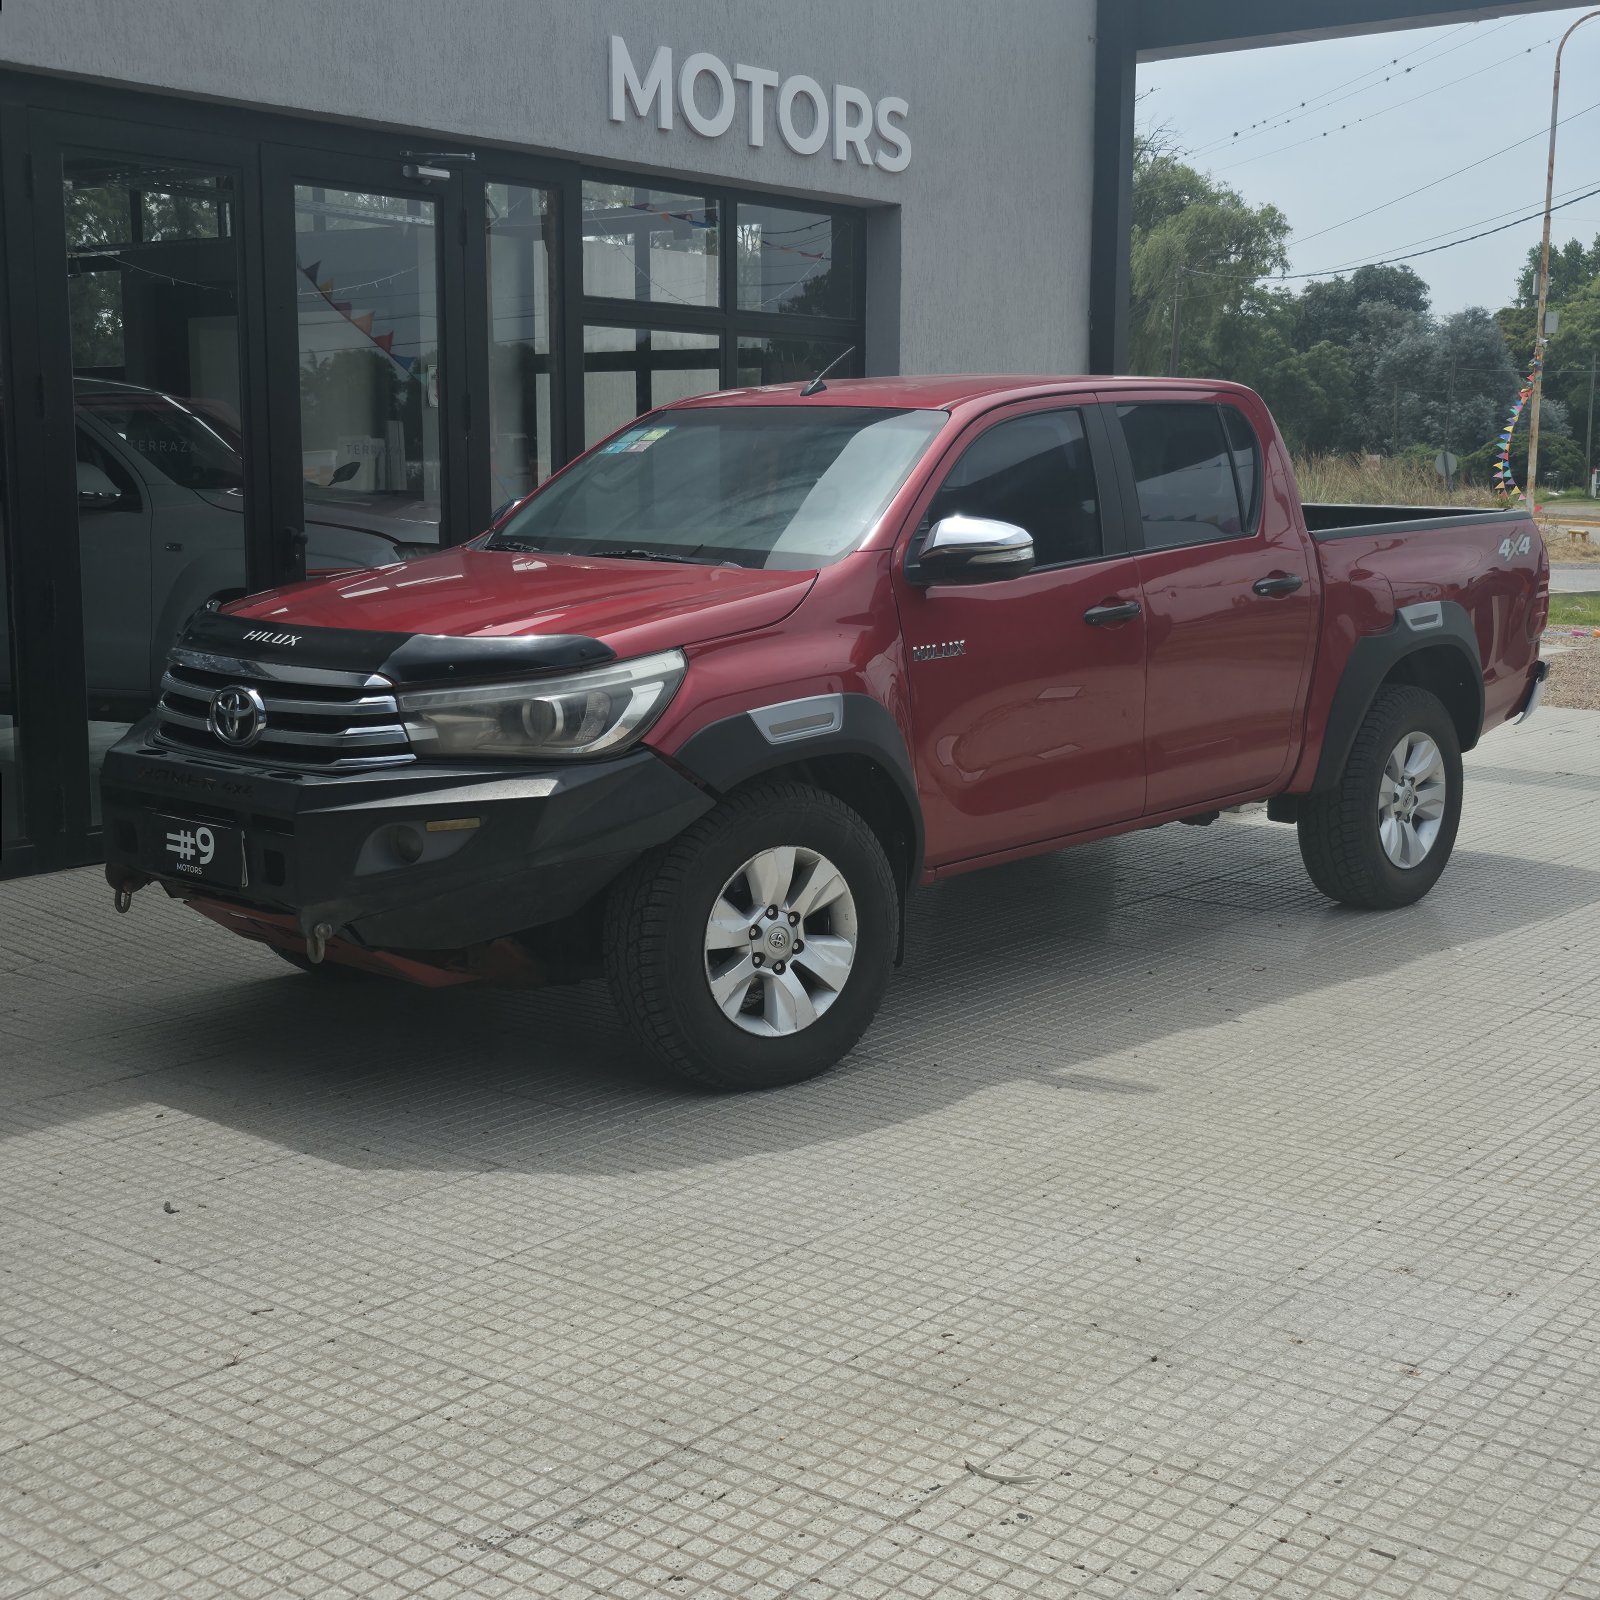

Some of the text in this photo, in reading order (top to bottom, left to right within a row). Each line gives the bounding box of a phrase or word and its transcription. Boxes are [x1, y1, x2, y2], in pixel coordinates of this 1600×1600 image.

[609, 35, 912, 173] MOTORS
[129, 439, 200, 453] TERRAZA
[243, 631, 303, 646] HILUX
[912, 640, 967, 661] HILUX
[166, 827, 215, 865] #9
[176, 862, 203, 875] MOTORS
